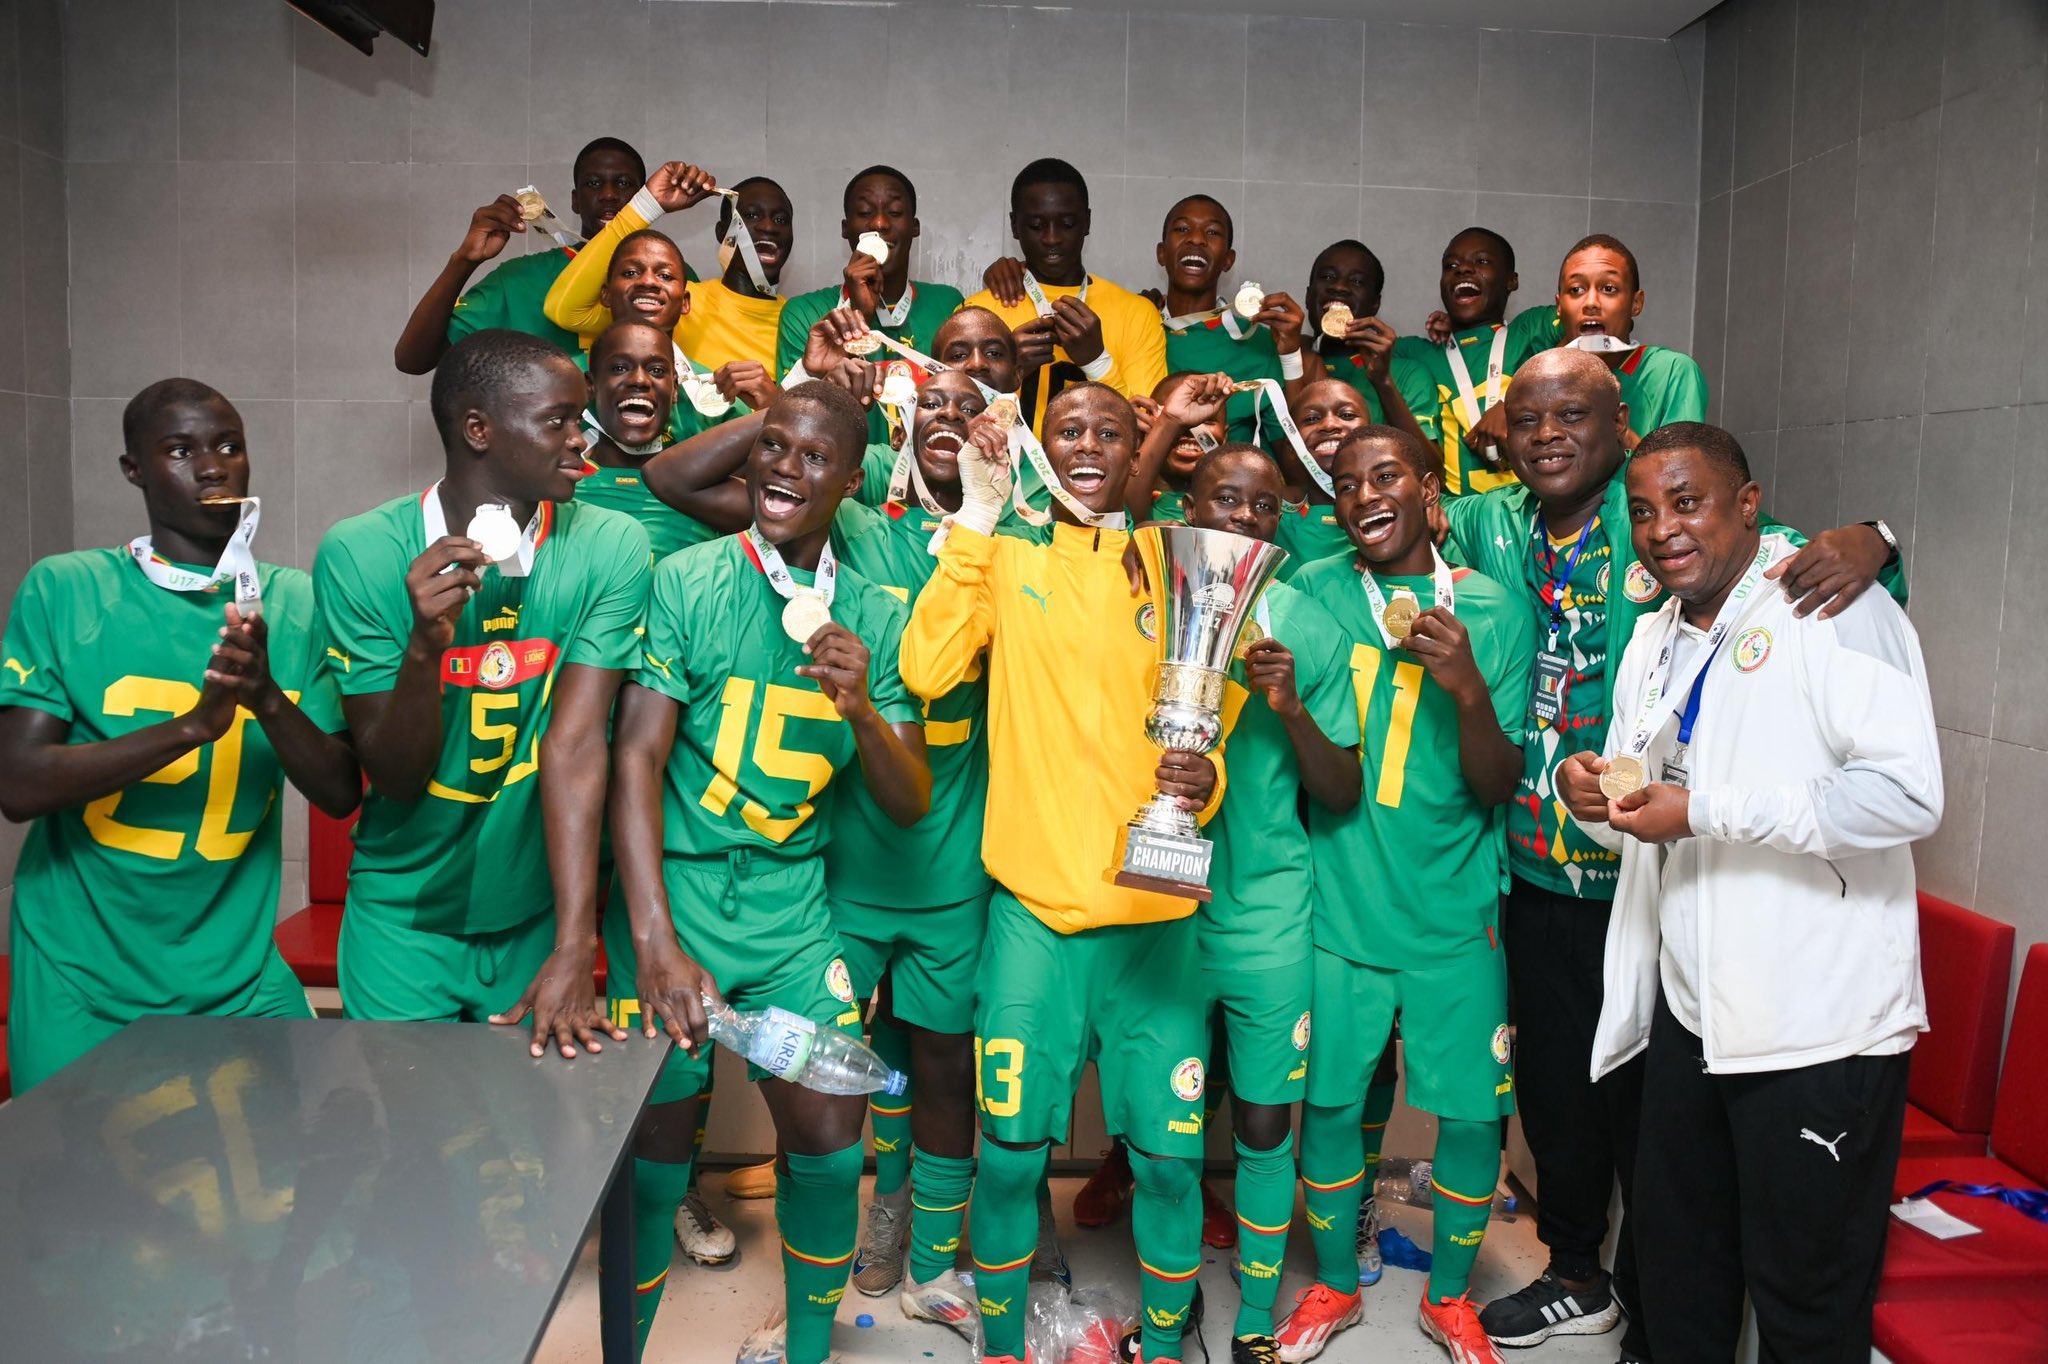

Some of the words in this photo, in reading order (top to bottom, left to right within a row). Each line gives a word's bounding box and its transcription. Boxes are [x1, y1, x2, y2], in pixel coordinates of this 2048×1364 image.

[1030, 448, 1051, 479] 2024
[1051, 484, 1070, 503] U17
[169, 572, 194, 588] U17
[1362, 574, 1375, 594] U17
[1734, 575, 1756, 599] U17
[482, 617, 515, 633] PUMA
[524, 651, 546, 664] LIONS
[470, 692, 519, 774] 5
[1349, 642, 1425, 809] 11
[699, 676, 843, 844] 15
[1132, 845, 1204, 878] CHAMPION
[836, 1010, 860, 1027] PUMA
[1167, 1120, 1199, 1135] PUMA
